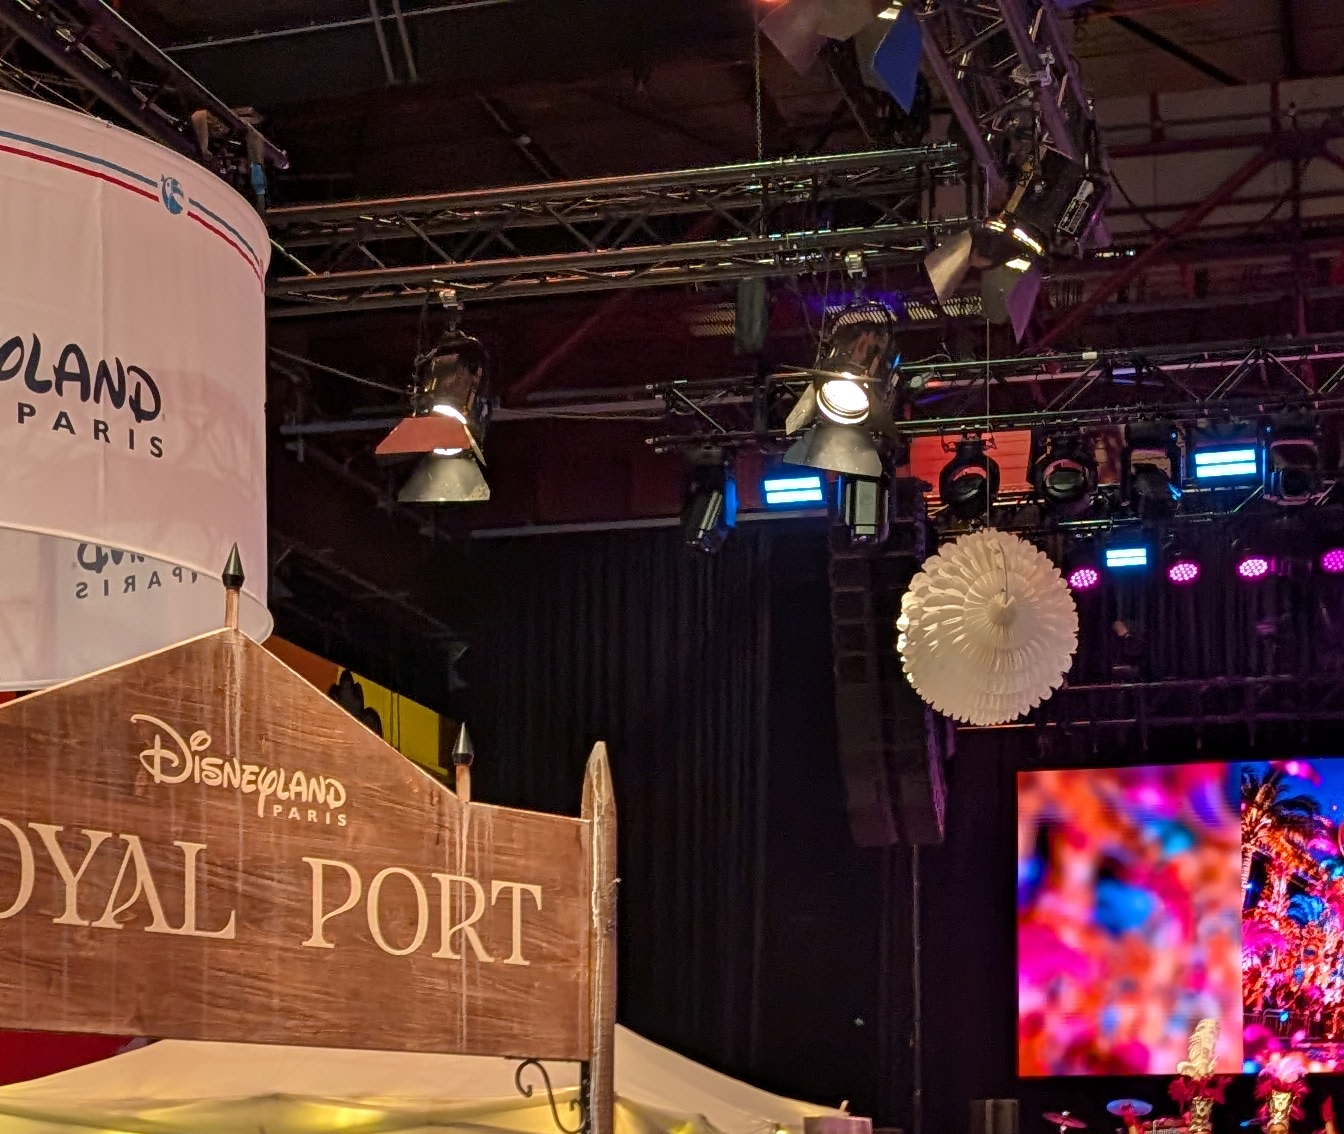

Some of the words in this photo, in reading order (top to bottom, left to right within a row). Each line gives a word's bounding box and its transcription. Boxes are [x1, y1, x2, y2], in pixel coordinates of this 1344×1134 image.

[17, 401, 164, 458] PARIS
[272, 804, 348, 827] PARIS
[302, 856, 542, 966] PORT
